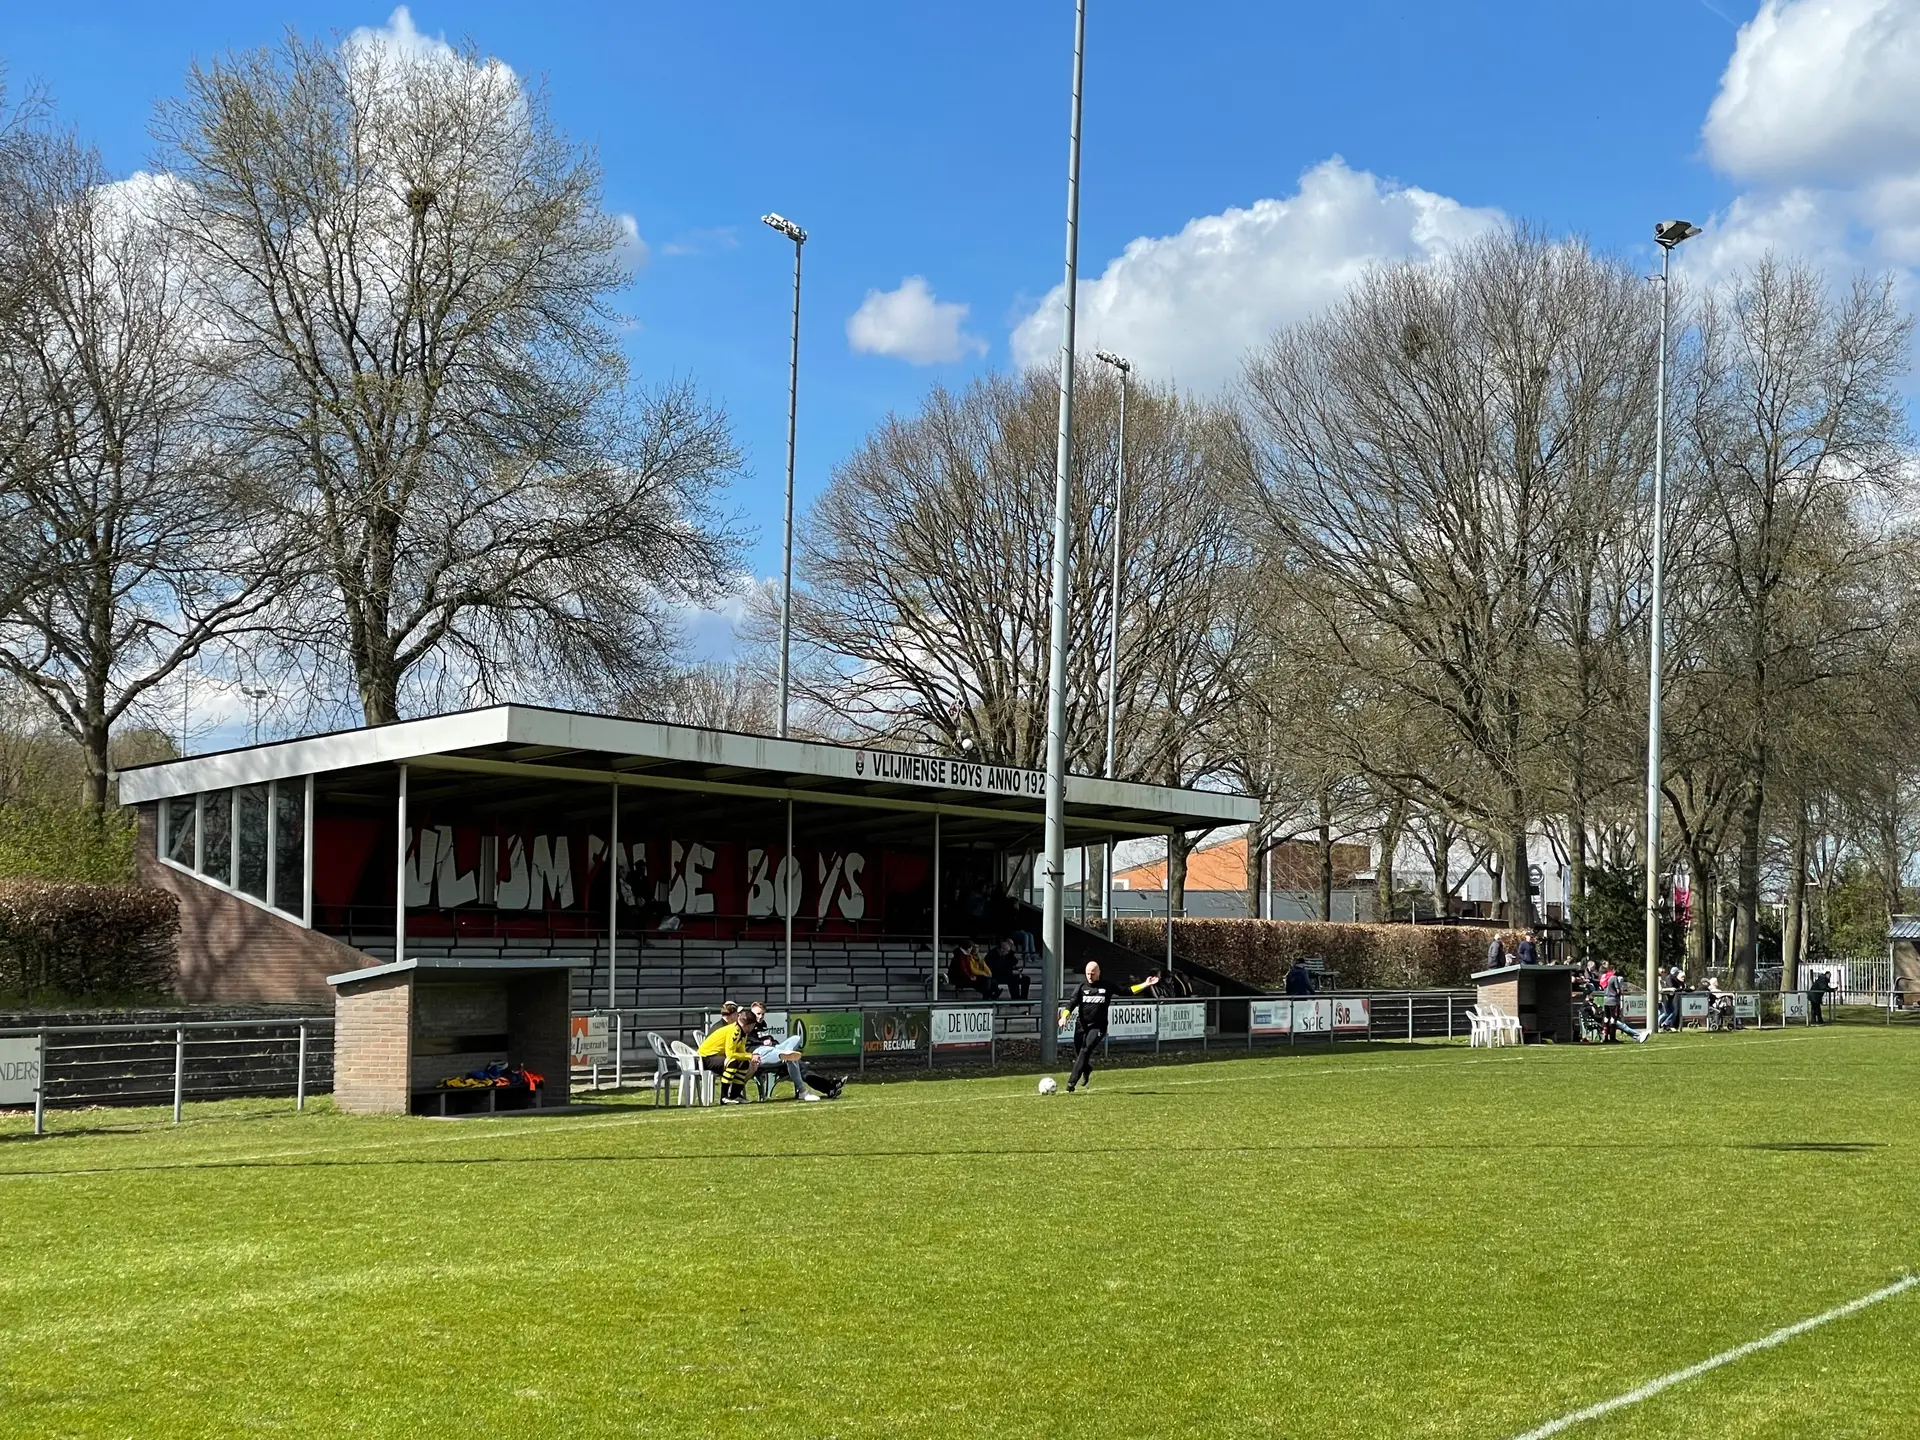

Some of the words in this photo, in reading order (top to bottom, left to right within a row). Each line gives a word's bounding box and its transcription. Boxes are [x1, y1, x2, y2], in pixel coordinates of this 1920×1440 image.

[873, 753, 946, 784] VLIJMENSE
[951, 762, 982, 788] BOYS
[987, 767, 1021, 792] ANNO
[1024, 772, 1046, 795] 192
[747, 848, 865, 926] BOYS
[948, 1013, 961, 1033] DE
[963, 1012, 991, 1032] VOGEL
[1112, 1007, 1152, 1025] BROEREN
[1302, 1015, 1324, 1031] SPIE
[883, 1039, 916, 1051] RECLAME
